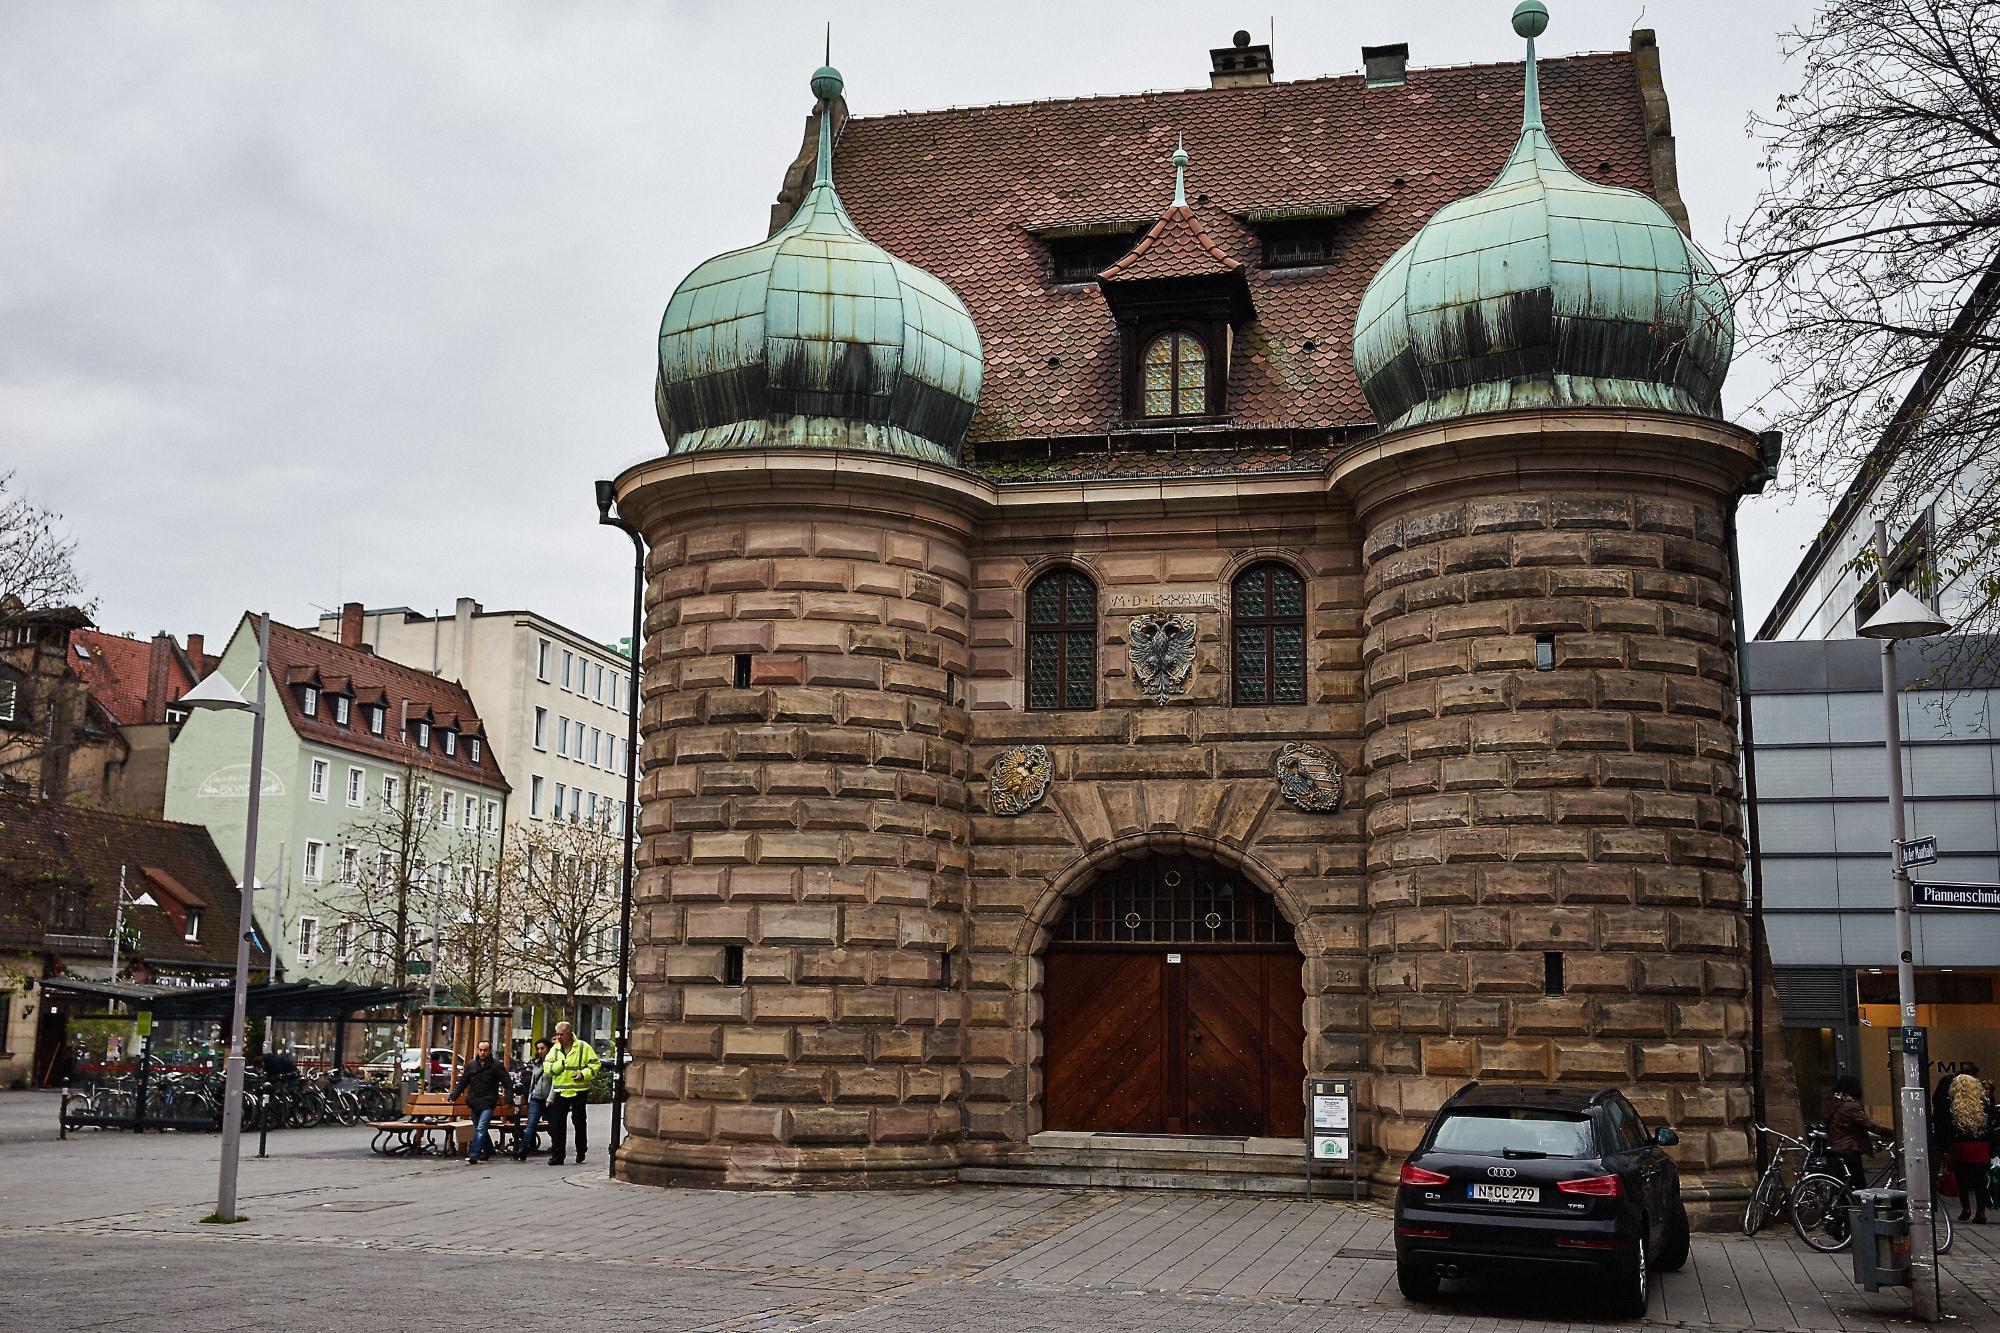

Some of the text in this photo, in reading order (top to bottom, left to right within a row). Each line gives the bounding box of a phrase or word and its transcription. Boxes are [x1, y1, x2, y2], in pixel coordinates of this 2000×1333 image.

[1336, 970, 1353, 984] 24
[1910, 1092, 1920, 1100] 12
[1478, 1185, 1487, 1197] N
[1512, 1187, 1535, 1201] 279
